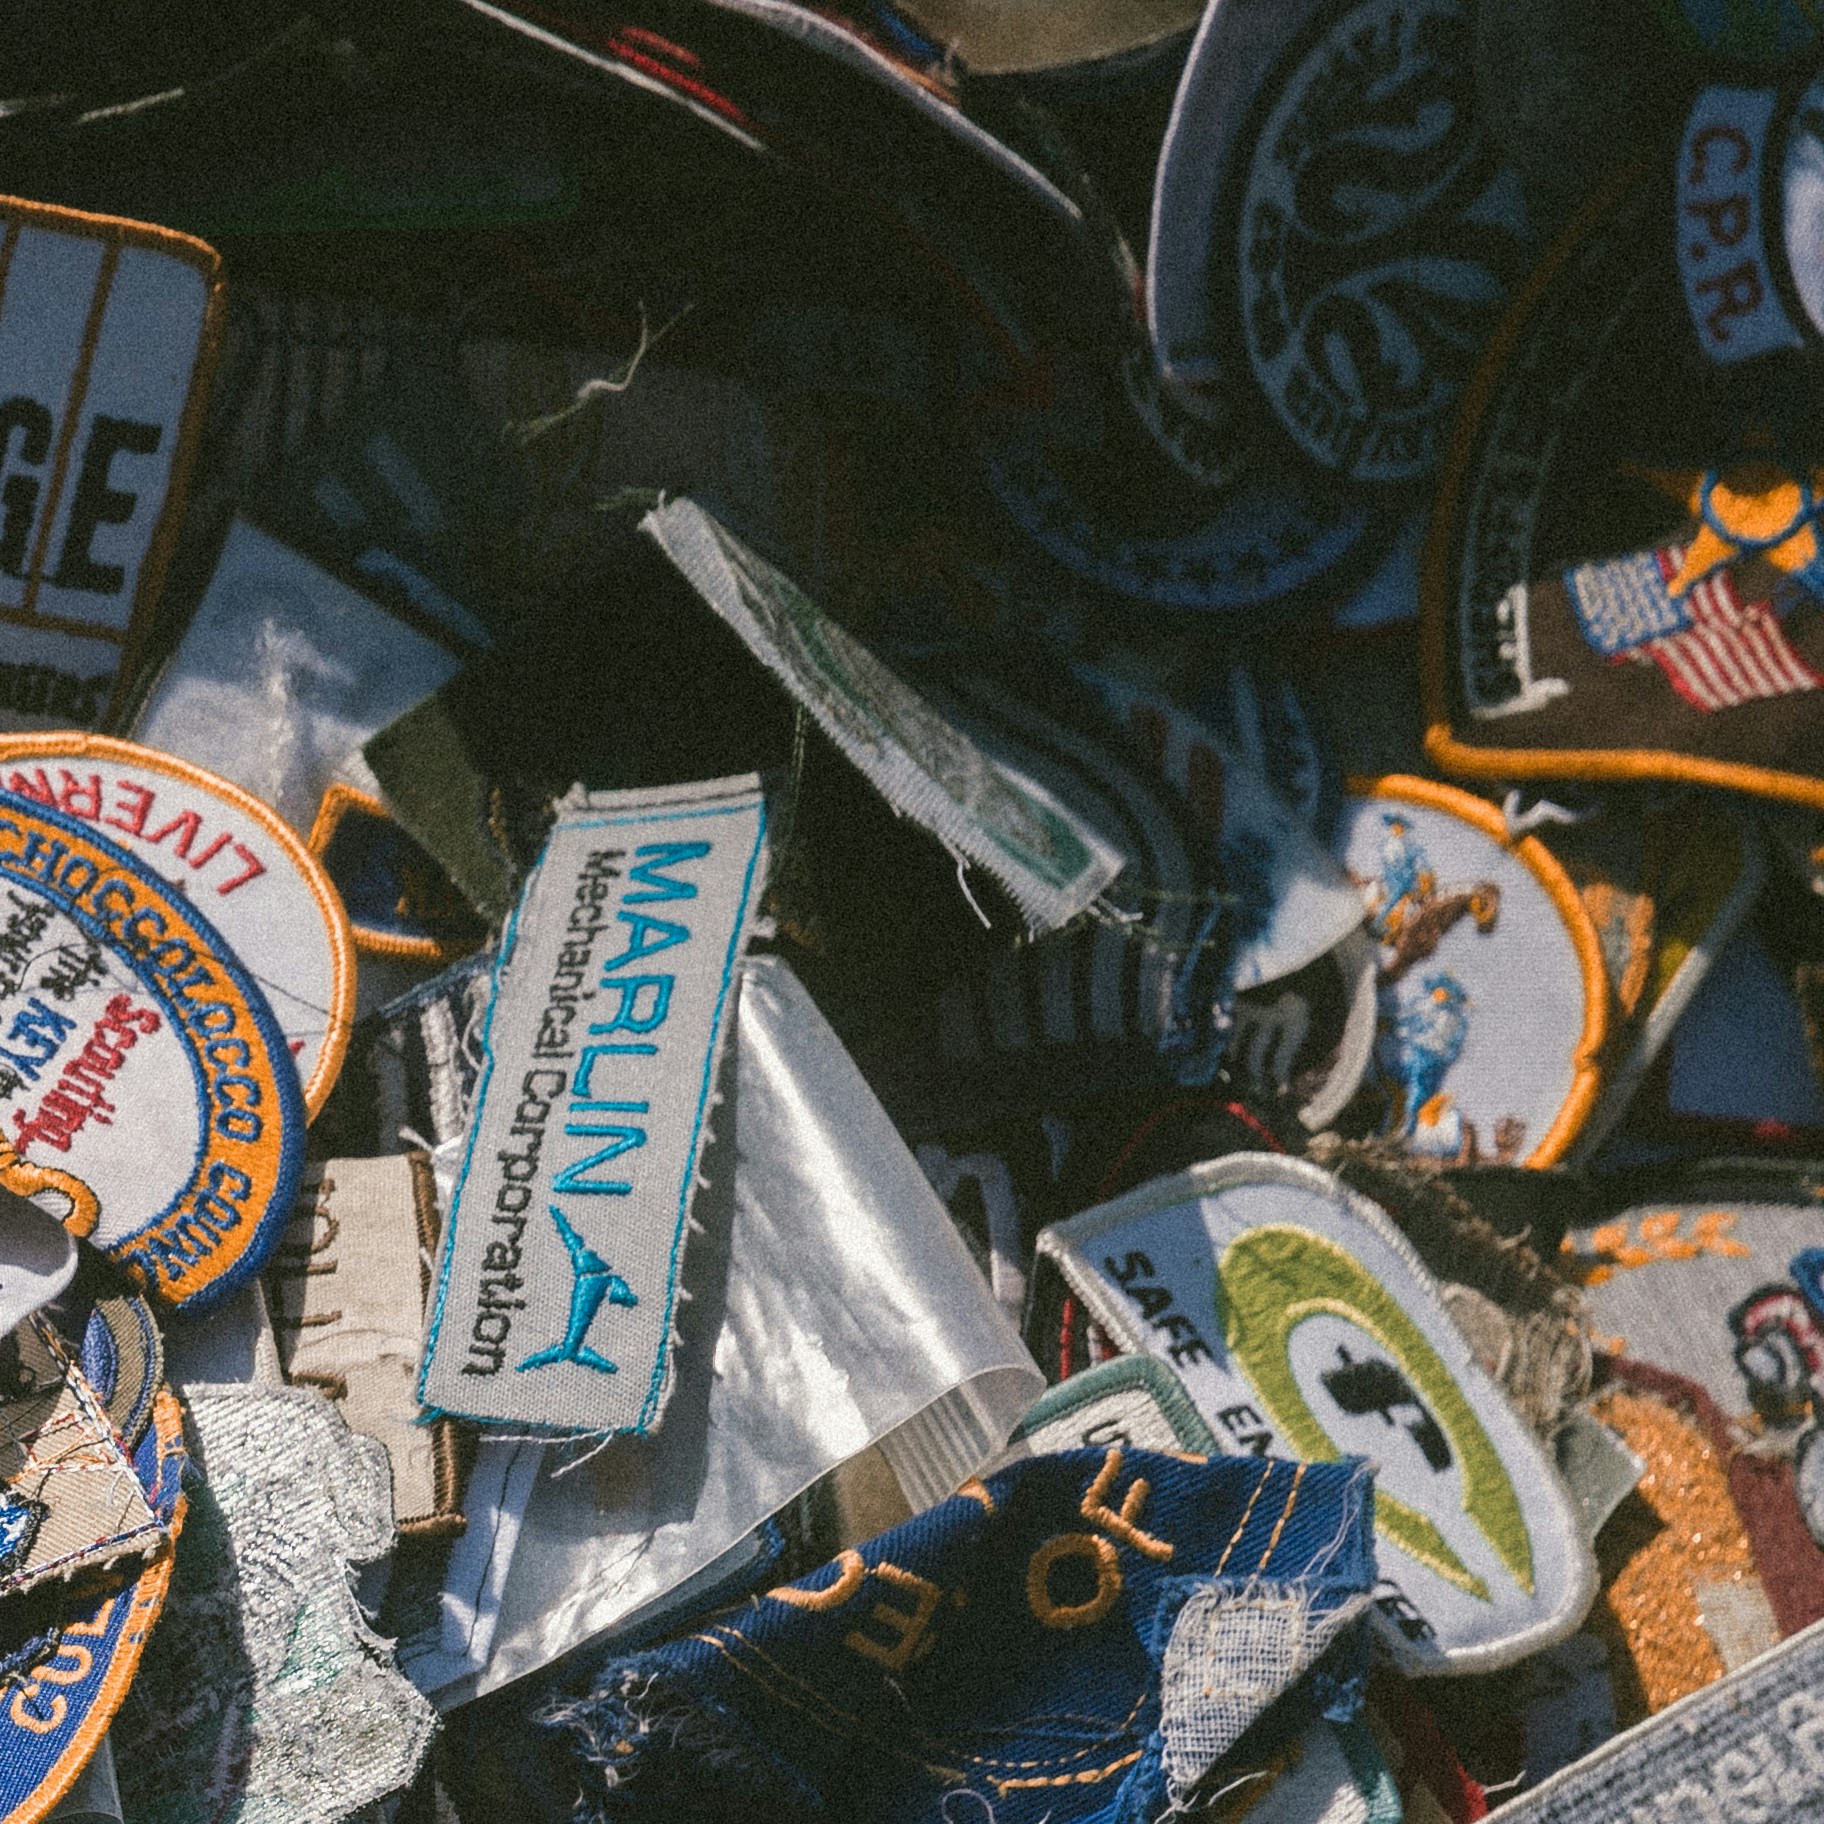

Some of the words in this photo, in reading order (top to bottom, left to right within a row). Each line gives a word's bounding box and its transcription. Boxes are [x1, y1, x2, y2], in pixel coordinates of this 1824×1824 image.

[11, 997, 78, 1082] KEY
[529, 848, 627, 1071] Mechanical
[551, 840, 712, 1199] MARLIN
[461, 1070, 566, 1379] Corporation
[1104, 1248, 1212, 1369] SAFE
